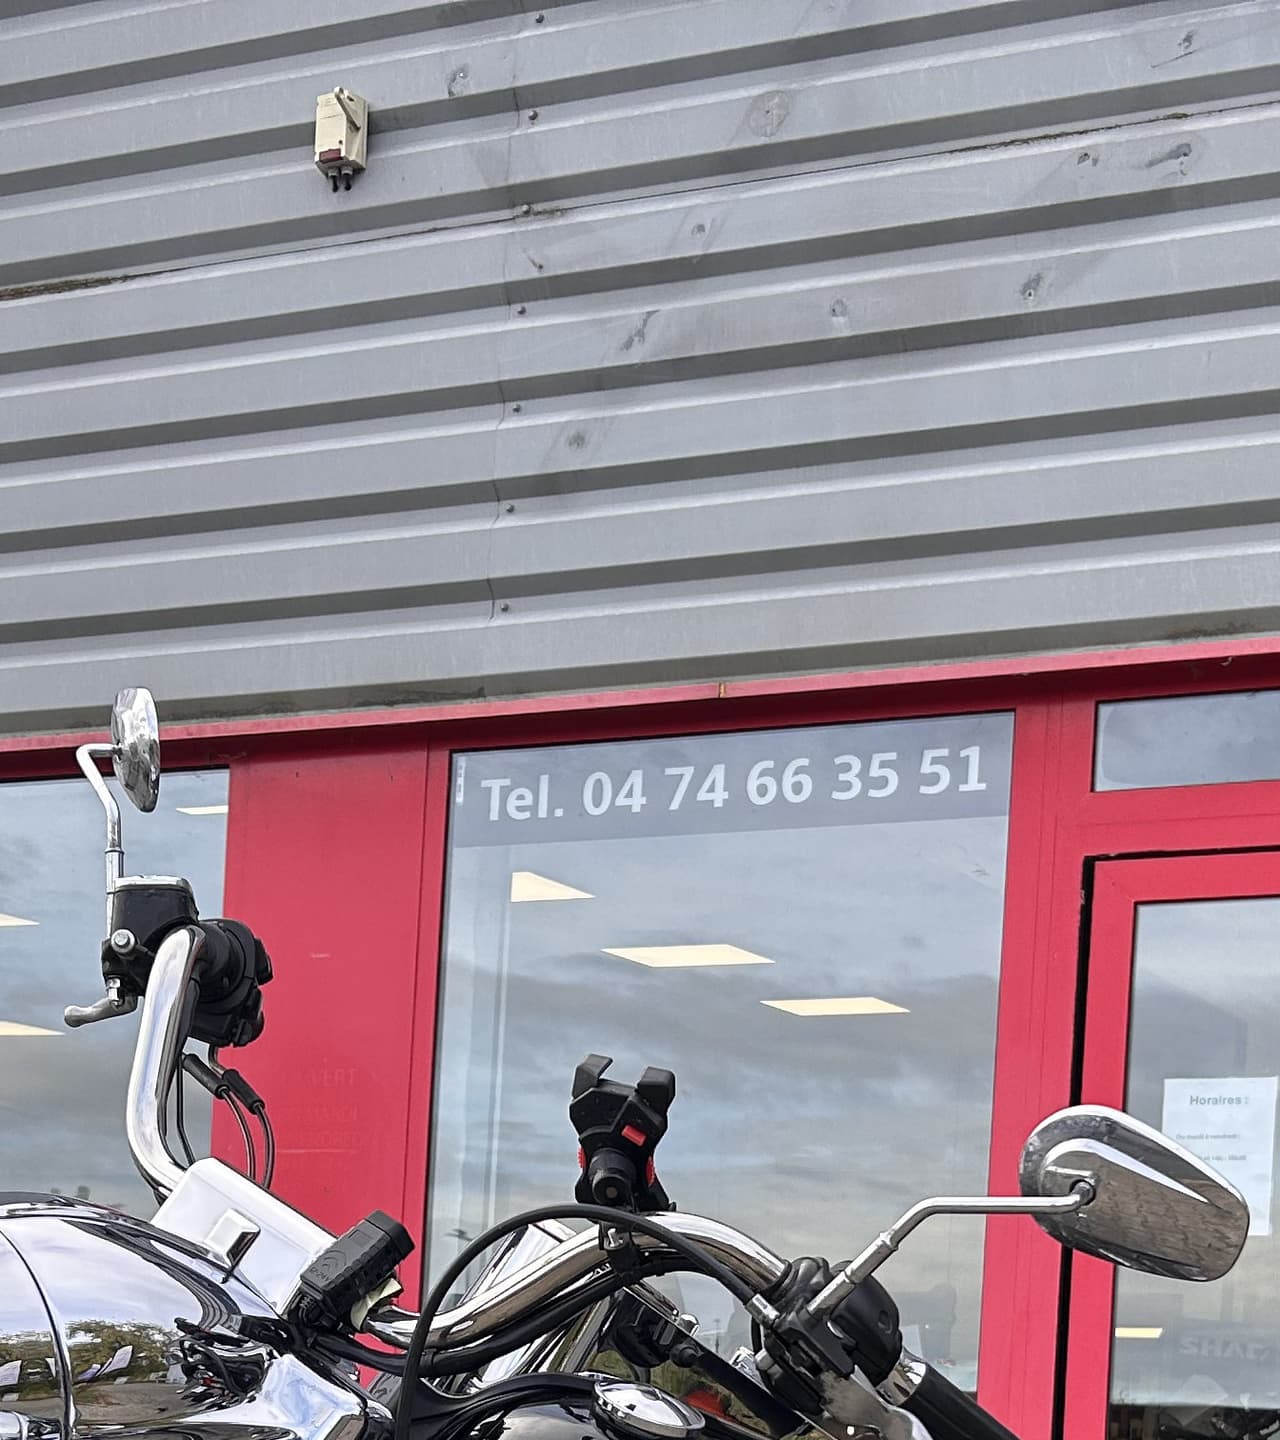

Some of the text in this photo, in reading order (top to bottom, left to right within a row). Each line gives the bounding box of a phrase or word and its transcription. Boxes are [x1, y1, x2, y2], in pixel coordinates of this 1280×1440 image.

[481, 745, 987, 821] Tel. 04 74 66 35 51
